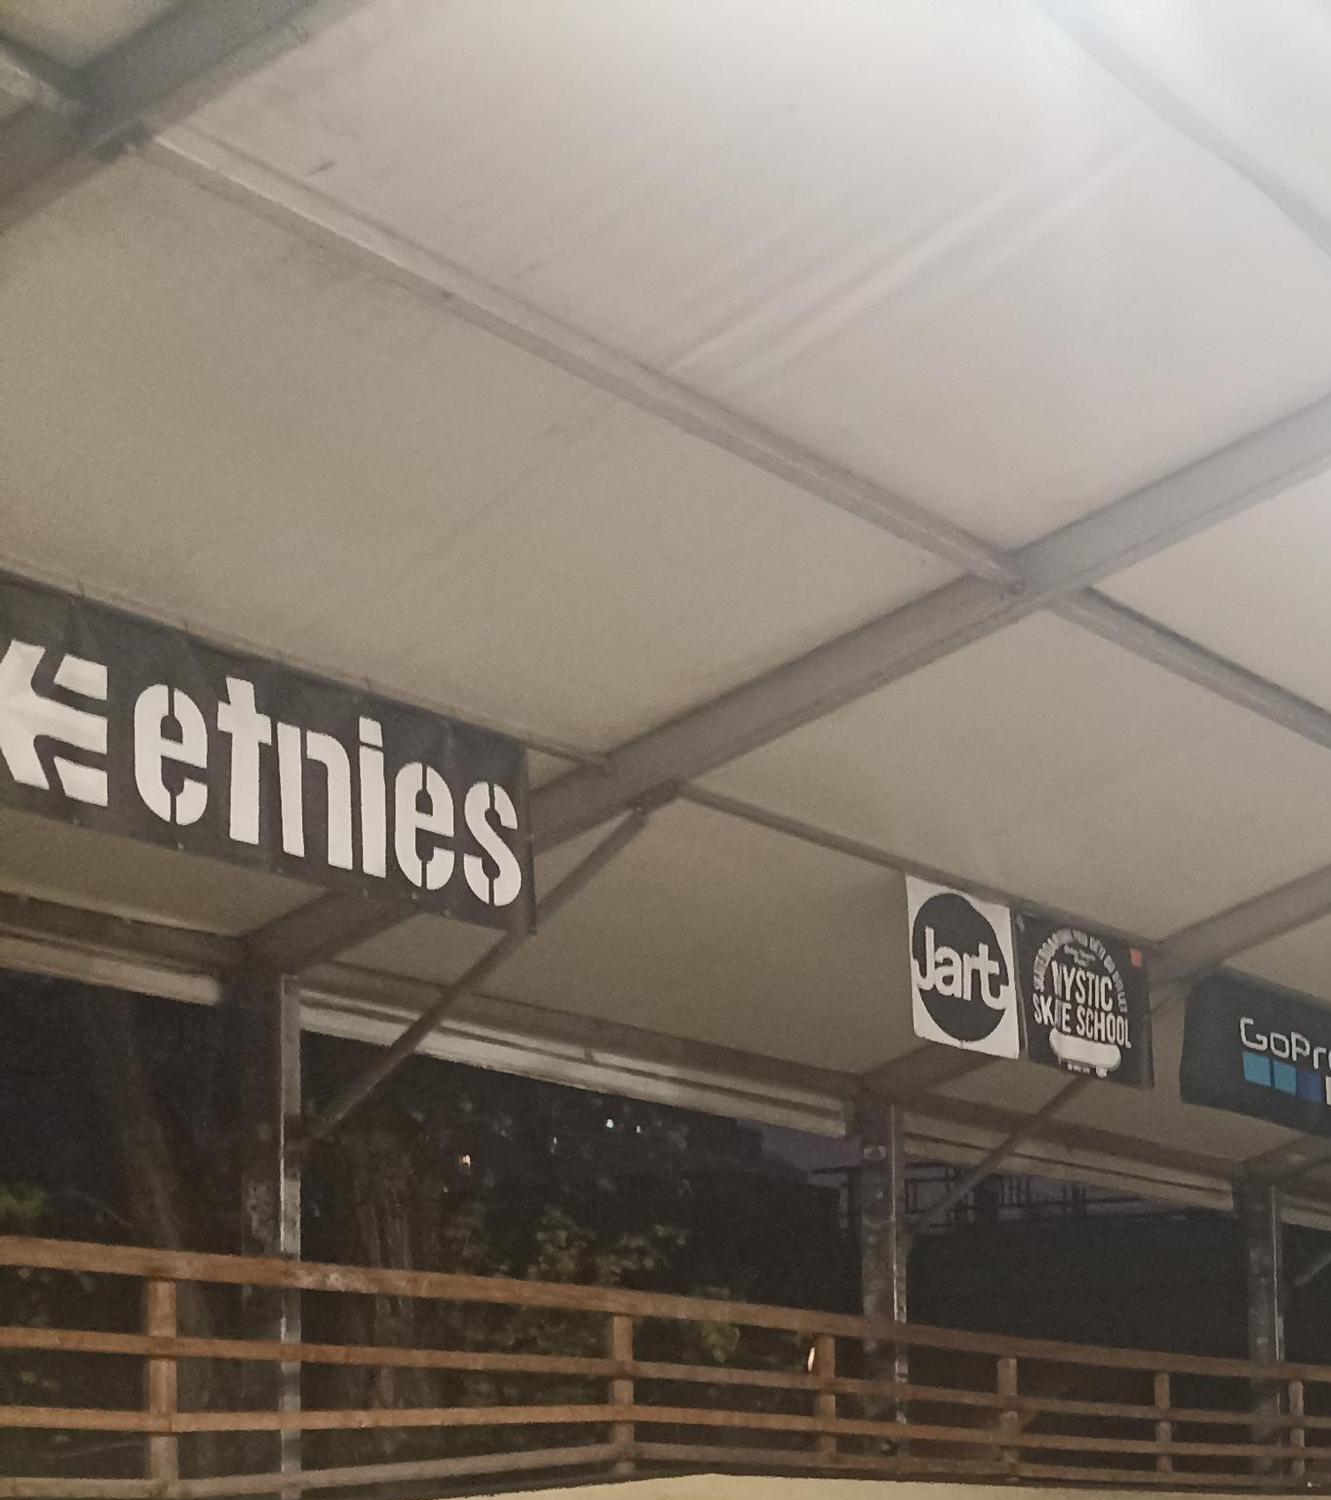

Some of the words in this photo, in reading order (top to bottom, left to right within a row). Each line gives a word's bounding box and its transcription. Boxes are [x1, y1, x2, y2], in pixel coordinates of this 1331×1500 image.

[134, 676, 522, 907] etnies
[1051, 961, 1113, 1012] MYSTIC
[1076, 1005, 1132, 1048] SCHOOL
